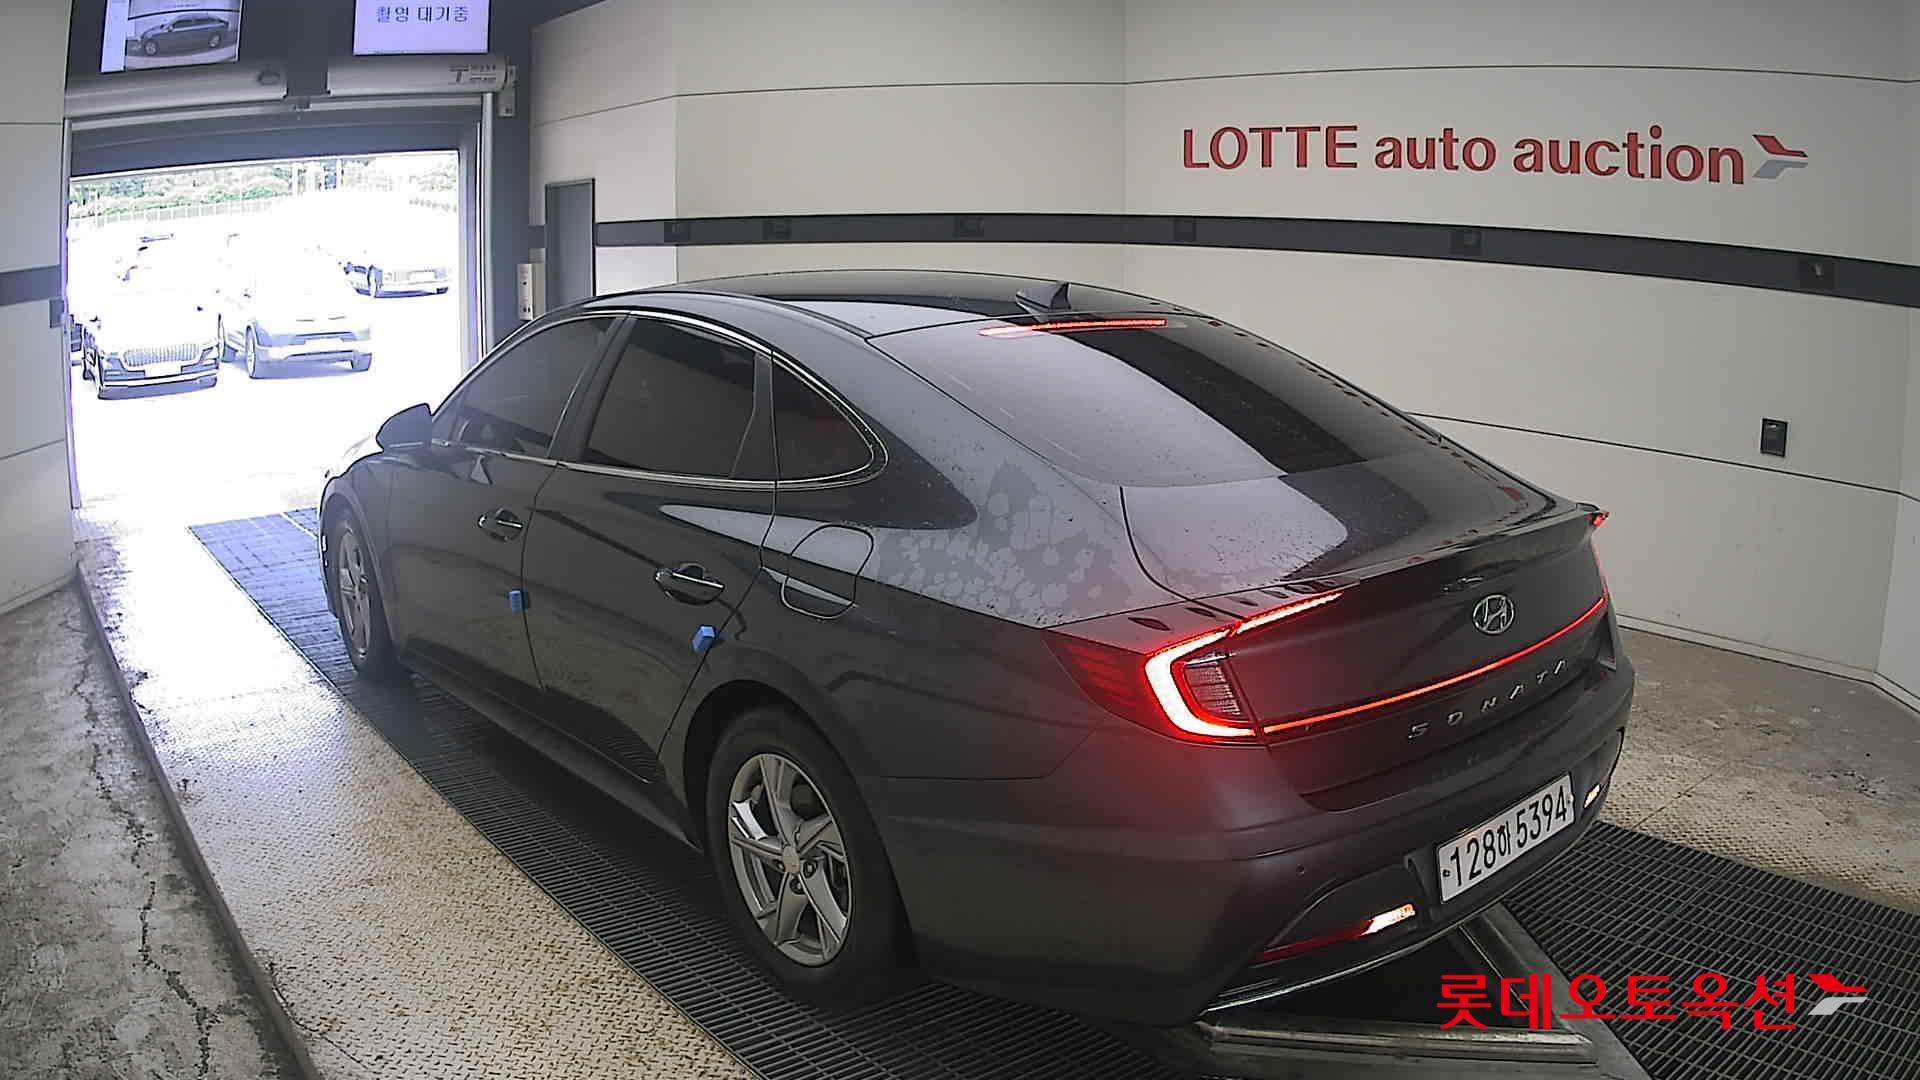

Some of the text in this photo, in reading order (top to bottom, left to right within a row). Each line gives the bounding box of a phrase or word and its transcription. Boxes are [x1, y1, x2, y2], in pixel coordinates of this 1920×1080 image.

[417, 5, 469, 23] 대기중
[1183, 125, 1745, 185] LOTTE auto auction
[1408, 658, 1567, 739] SONATA
[1516, 785, 1567, 848] 5394
